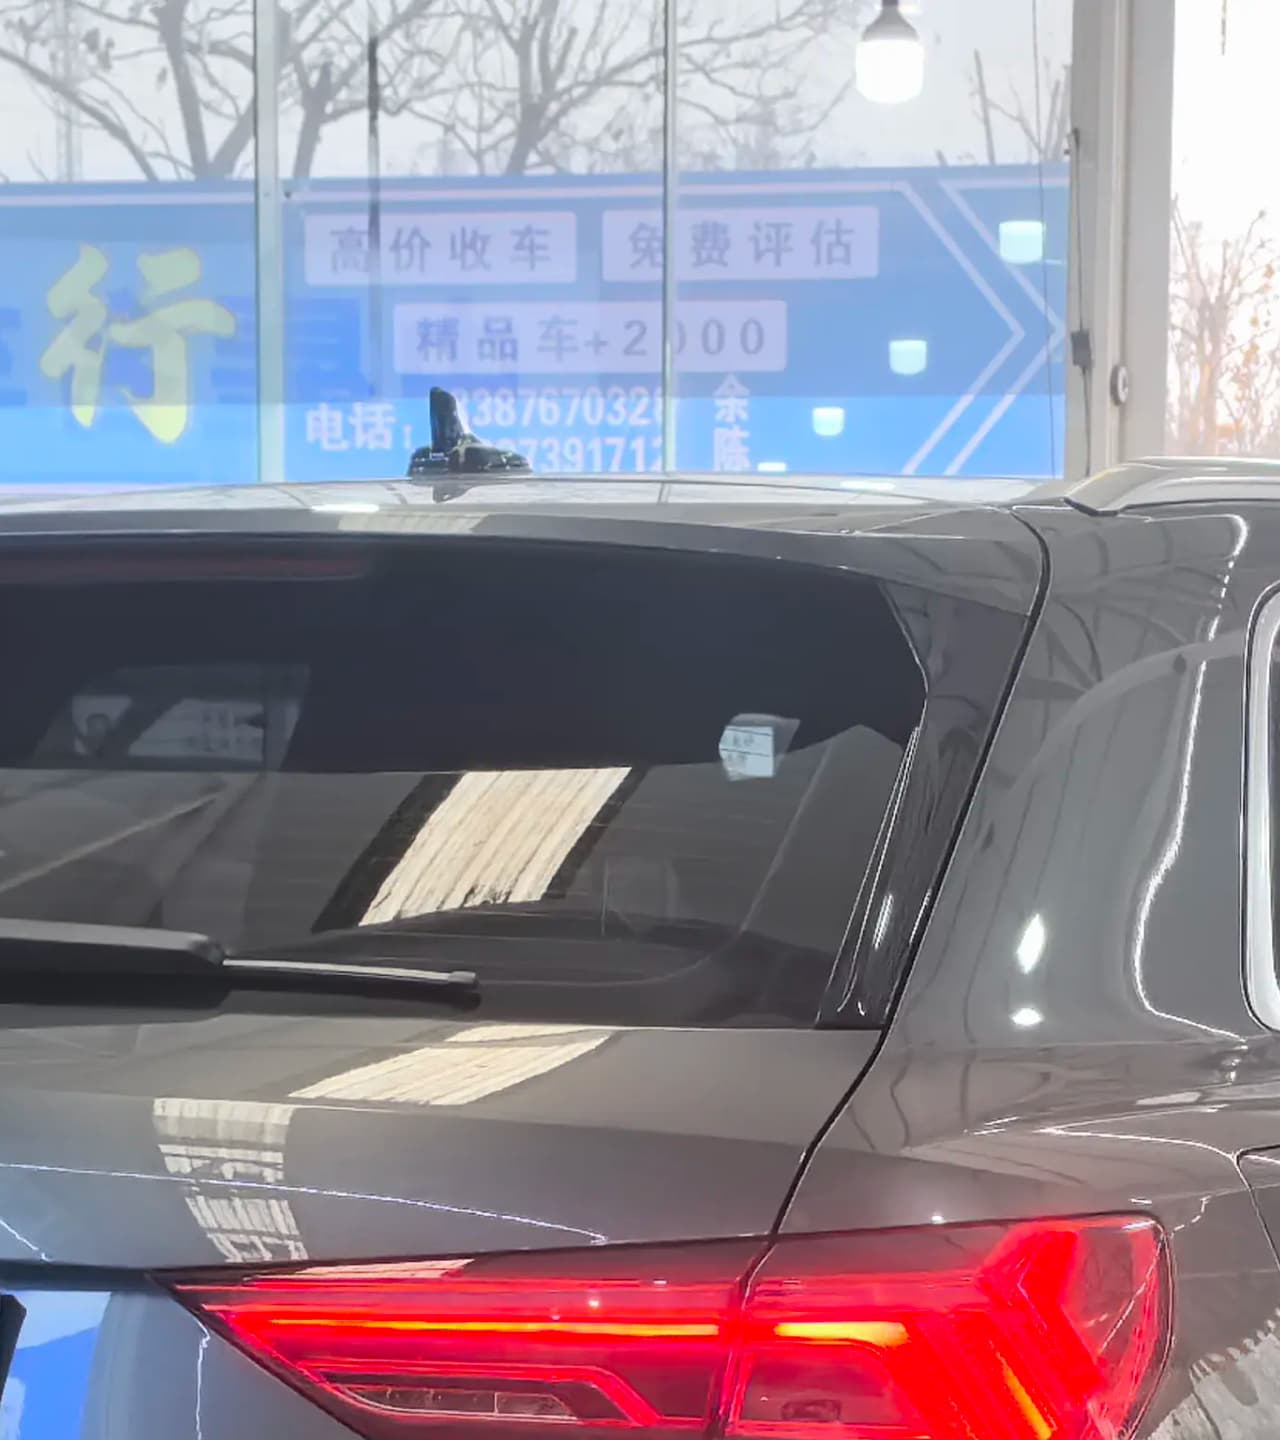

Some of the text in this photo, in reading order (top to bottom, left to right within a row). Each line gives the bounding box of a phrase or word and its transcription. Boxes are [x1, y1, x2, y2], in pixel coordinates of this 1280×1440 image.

[329, 223, 553, 274] 高价收车
[627, 217, 857, 270] 免费评估
